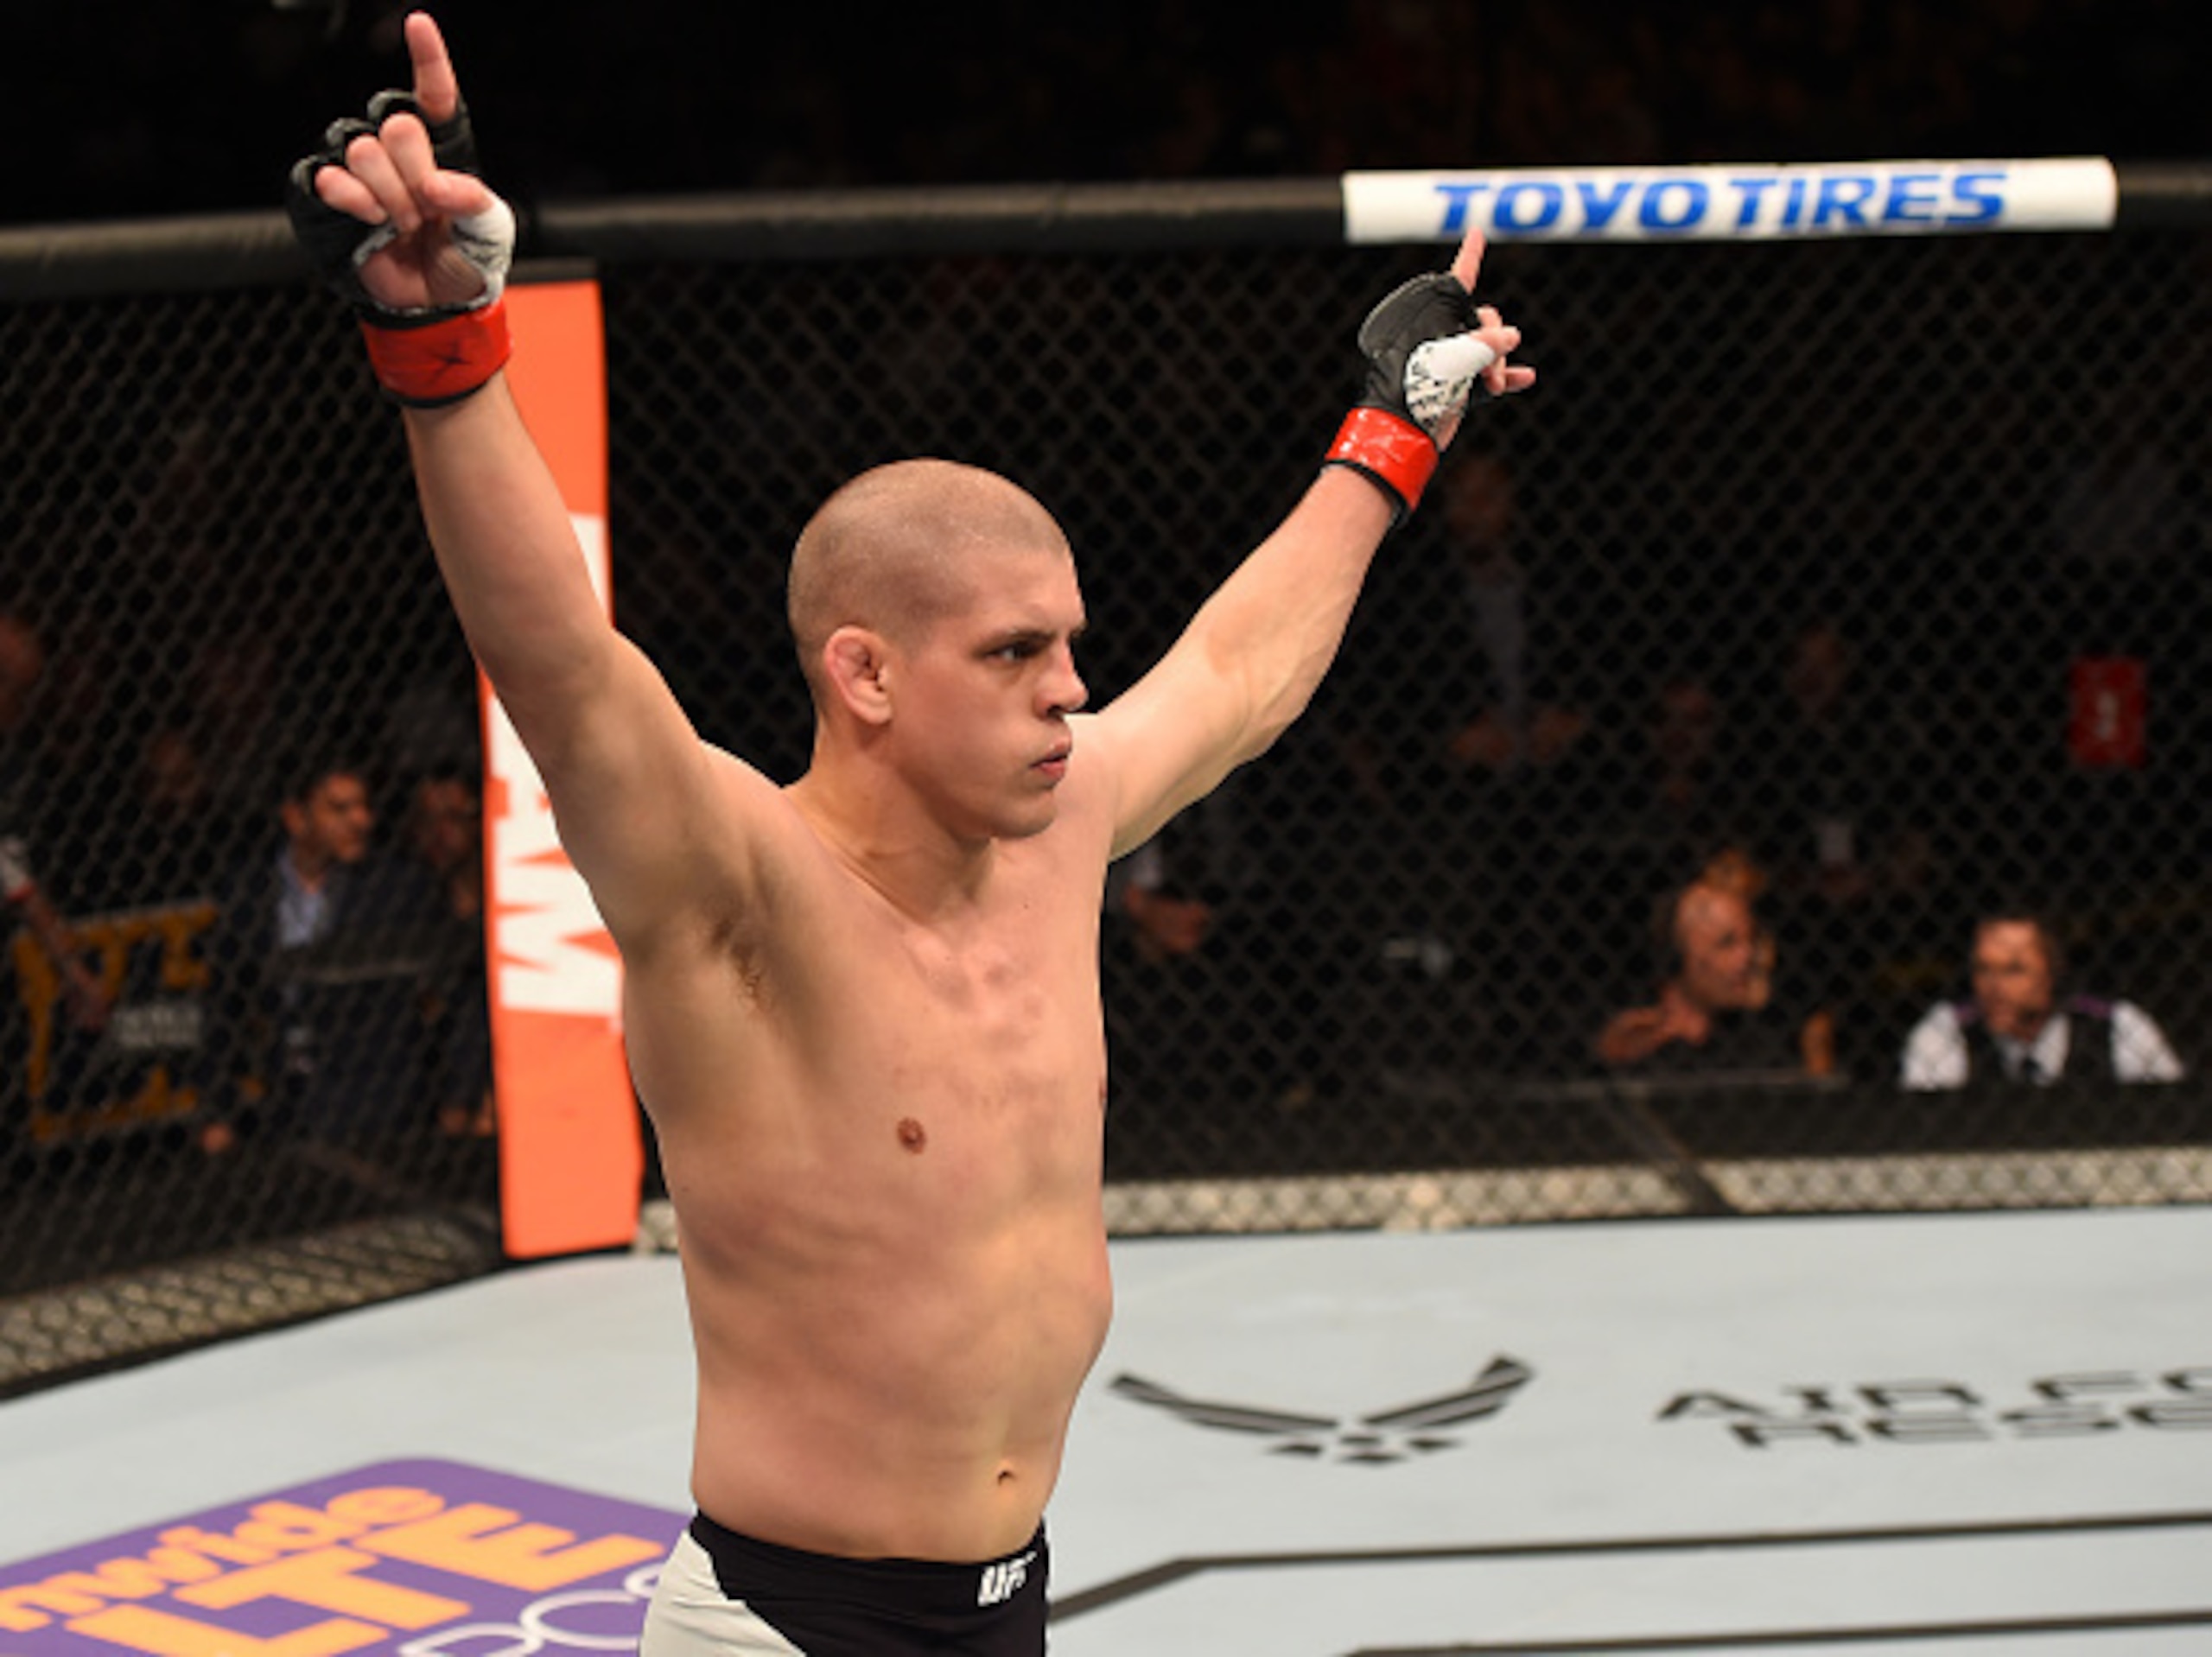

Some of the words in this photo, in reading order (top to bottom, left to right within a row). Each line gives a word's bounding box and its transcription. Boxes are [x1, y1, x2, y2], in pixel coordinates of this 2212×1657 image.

[1435, 179, 1710, 234] TOYO
[1730, 173, 2006, 229] TIRES
[63, 1501, 665, 1657] LTE
